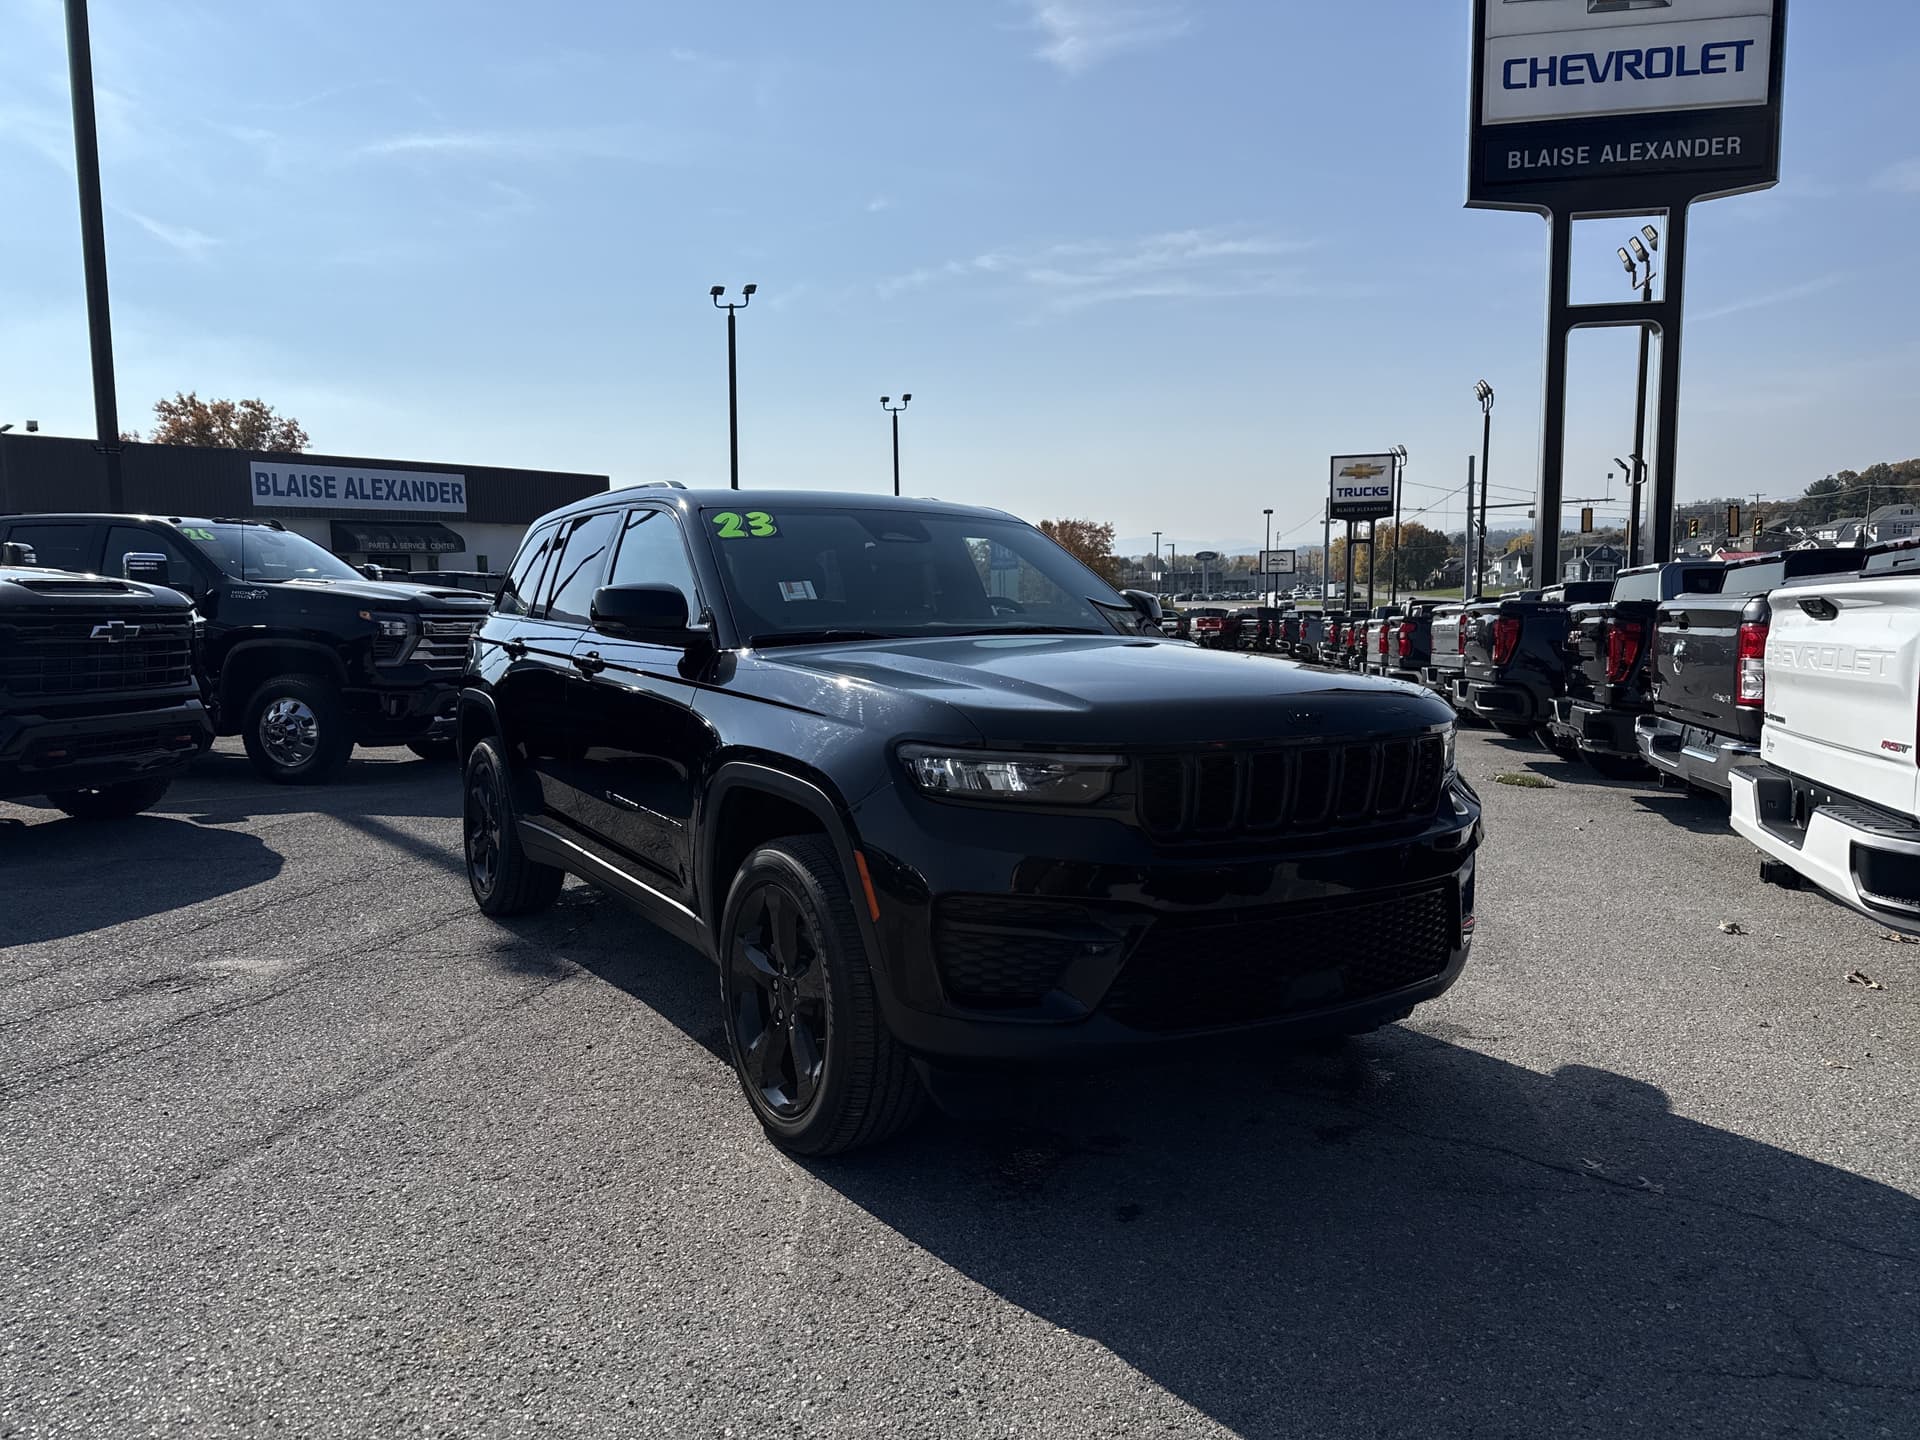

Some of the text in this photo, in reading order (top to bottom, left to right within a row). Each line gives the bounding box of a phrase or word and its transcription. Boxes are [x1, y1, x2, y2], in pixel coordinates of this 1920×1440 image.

[1502, 39, 1754, 90] CHEVROLET
[1508, 136, 1742, 169] BLAISE ALEXANDER
[255, 471, 465, 504] BLAISE ALEXANDER
[1336, 486, 1389, 497] TRUCKS
[182, 528, 216, 540] 26
[712, 511, 777, 538] 23
[1881, 740, 1912, 754] RST
